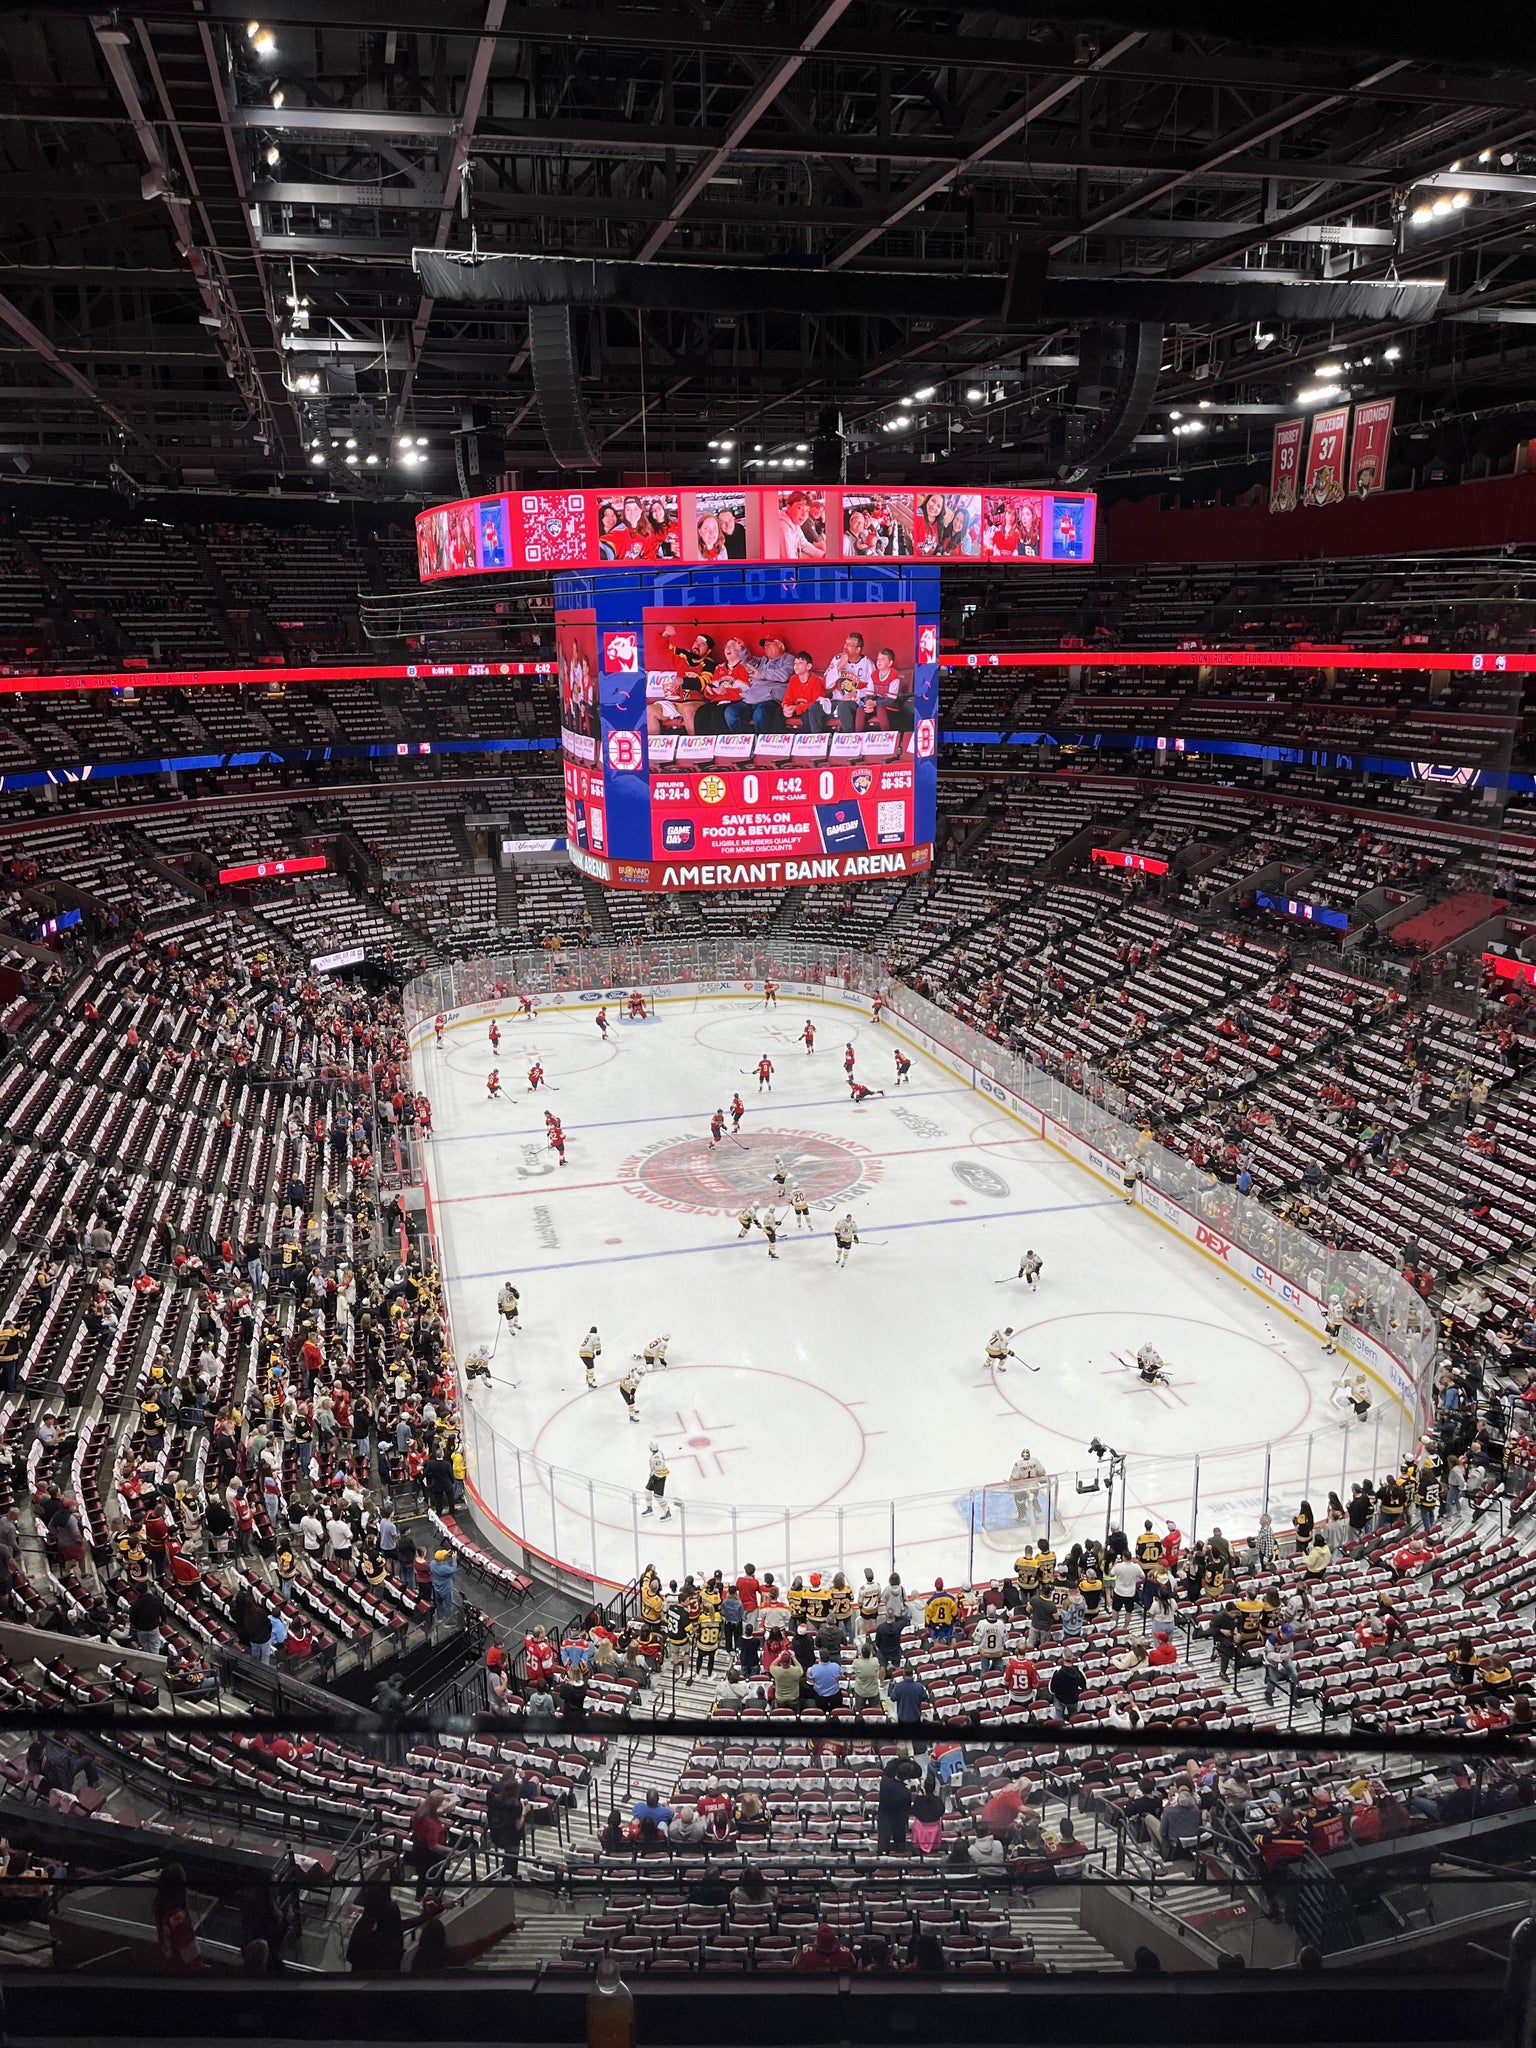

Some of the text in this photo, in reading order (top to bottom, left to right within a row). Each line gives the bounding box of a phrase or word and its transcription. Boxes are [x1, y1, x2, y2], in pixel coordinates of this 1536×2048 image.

[1358, 405, 1389, 425] LUONGO
[1315, 415, 1344, 433] HUIZENGA
[1366, 426, 1373, 449] 1
[1319, 436, 1336, 460] 37
[1280, 447, 1294, 470] 93
[681, 737, 713, 748] AUTISM
[720, 735, 751, 745] AUTISM
[760, 734, 790, 744] AUTISM
[797, 735, 826, 745] AUTISM
[866, 733, 894, 743] AUTISM
[743, 774, 759, 804] 0
[776, 777, 802, 793] 4:42
[820, 771, 834, 800] 0
[881, 776, 912, 789] 36-35-3
[653, 788, 690, 800] 43-24-8
[722, 813, 791, 825] SAVE 5% ON
[667, 826, 691, 834] GAME
[702, 823, 810, 837] FOOD & BEVERAGE
[826, 820, 858, 836] GAMEDAY
[666, 835, 681, 844] DAY
[741, 838, 773, 846] MEMBERS
[756, 844, 793, 852] DISCOUNTS
[662, 863, 781, 887] AMERANT
[785, 856, 840, 881] BANK
[843, 853, 906, 877] ARENA
[795, 1193, 805, 1203] 20
[1195, 1225, 1231, 1261] DEX
[1256, 1266, 1272, 1286] CH
[1283, 1285, 1300, 1306] CH
[1142, 1547, 1159, 1561] 40
[835, 1599, 850, 1613] 73
[938, 1606, 945, 1620] 8
[701, 1628, 719, 1644] 88
[987, 1634, 996, 1649] 8
[1012, 1675, 1029, 1690] 19
